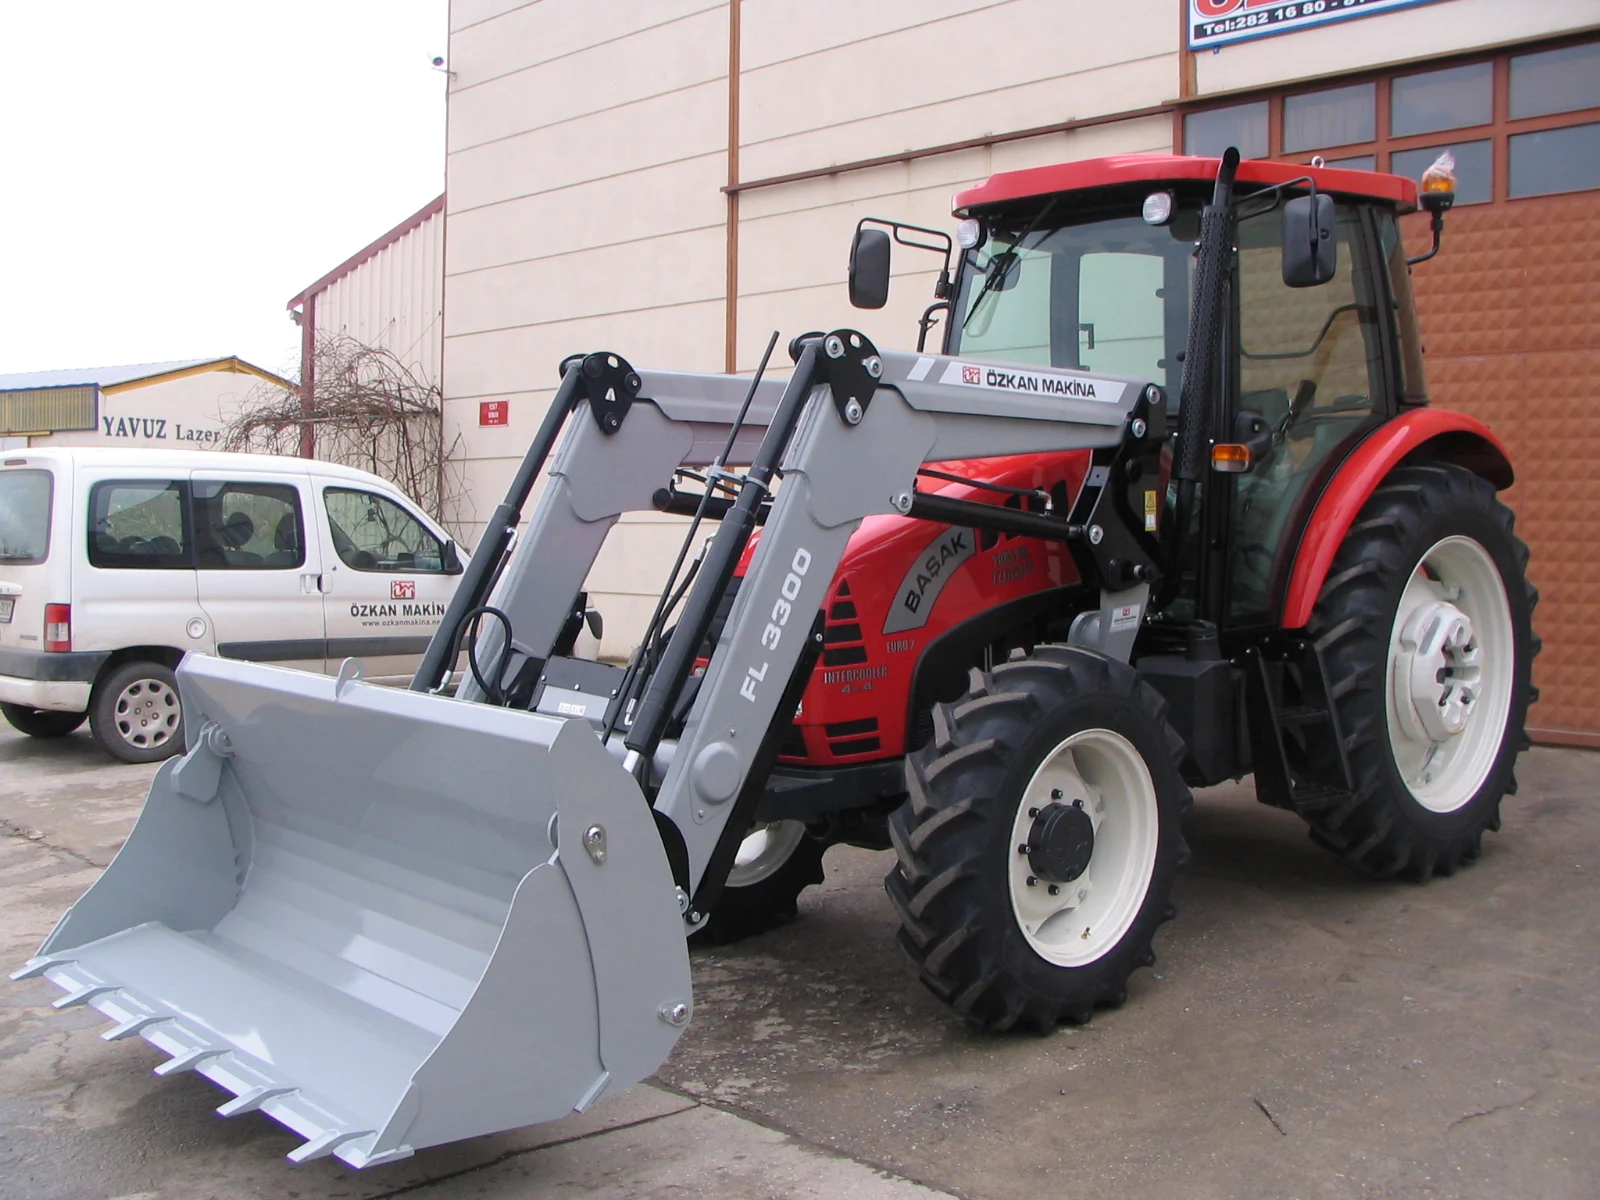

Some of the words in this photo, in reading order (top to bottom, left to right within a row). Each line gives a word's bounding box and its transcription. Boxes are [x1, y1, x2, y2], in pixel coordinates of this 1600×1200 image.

[1202, 13, 1269, 36] Tel:282
[1274, 8, 1297, 21] 16
[1302, 2, 1326, 15] 80
[986, 369, 1038, 391] ÖZKAN
[1042, 378, 1096, 398] MAKİNA
[102, 416, 167, 439] YAVUZ
[175, 424, 222, 442] Lazer
[904, 532, 968, 614] BAŞAK
[350, 603, 397, 617] ÖZKAN
[403, 602, 445, 616] MAKİN
[361, 619, 441, 627] www.ozkanmakina.ne
[739, 662, 769, 703] FL
[761, 548, 812, 650] 3300
[886, 640, 908, 653] EURO
[824, 666, 888, 684] INTERCOOLER
